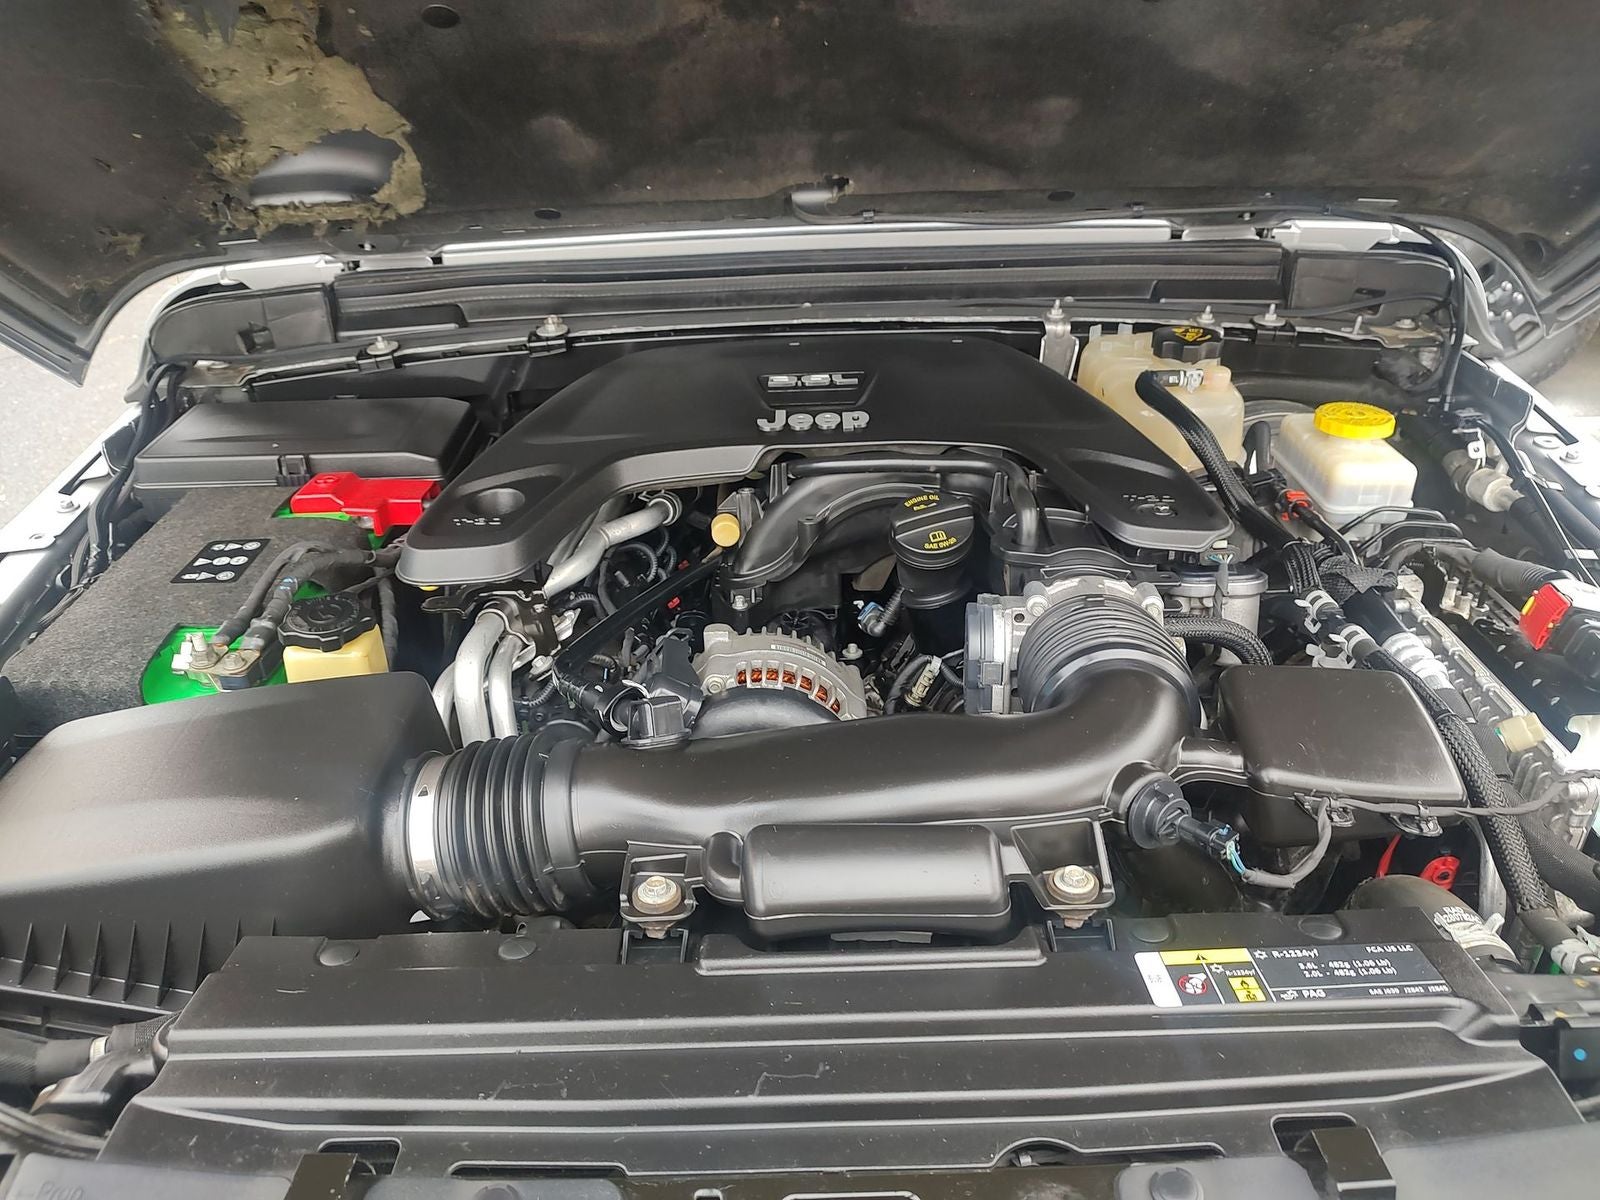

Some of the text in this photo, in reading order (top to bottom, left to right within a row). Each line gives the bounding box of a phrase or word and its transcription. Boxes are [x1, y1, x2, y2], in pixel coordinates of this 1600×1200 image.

[756, 409, 870, 433] Jeep
[904, 495, 928, 508] ENGINE
[924, 542, 938, 550] SAE
[1365, 944, 1413, 954] FCA US LLC
[1302, 989, 1326, 999] PAG
